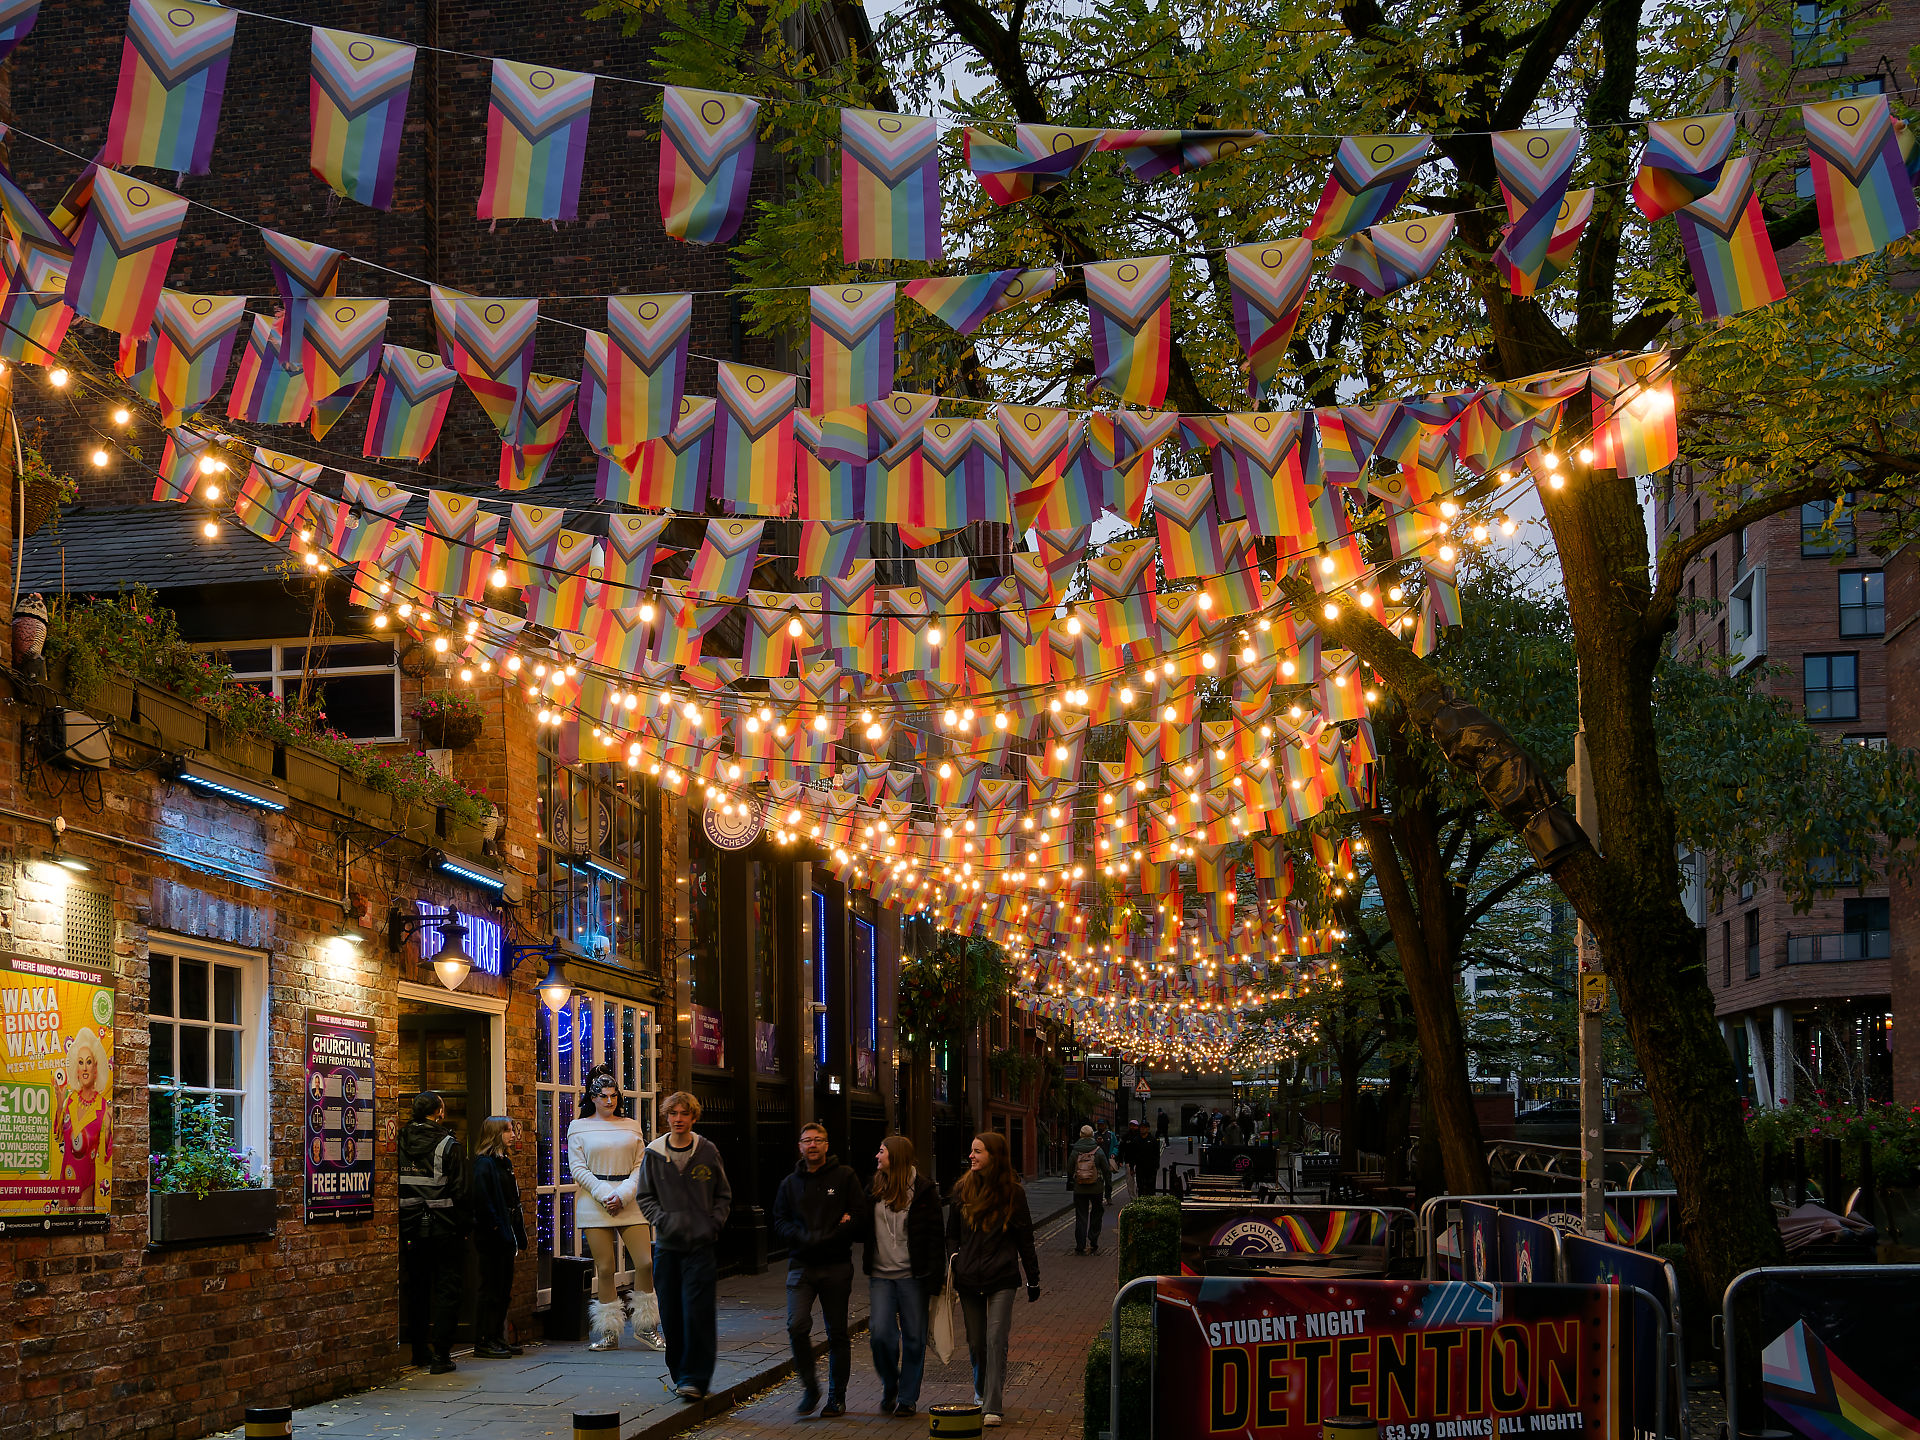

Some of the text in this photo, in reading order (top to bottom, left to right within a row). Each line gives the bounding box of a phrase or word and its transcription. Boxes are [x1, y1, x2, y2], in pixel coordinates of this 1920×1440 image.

[708, 824, 758, 847] MANCHESTER
[457, 911, 501, 976] HURCH
[11, 959, 102, 983] WHERE MUSIC COMES TO LIFE
[2, 986, 59, 1014] WAKA
[5, 1012, 60, 1033] BINGO
[6, 1030, 62, 1058] WAKA
[313, 1036, 371, 1058] CHURCH LIVE
[6, 1061, 36, 1074] MISTY
[312, 1054, 328, 1064] EVERY
[328, 1055, 347, 1066] FRIDAY
[346, 1057, 360, 1068] FROM
[0, 1085, 49, 1115] £100
[0, 1114, 49, 1126] AR TAB FOR A
[0, 1123, 49, 1134] ULL HOUSE WIN
[14, 1133, 20, 1141] A
[21, 1133, 49, 1142] CHANCE
[22, 1143, 49, 1152] BIGGER
[0, 1186, 22, 1195] EVERY
[24, 1186, 60, 1195] THURSDAY
[67, 1186, 80, 1194] 7PM
[311, 1172, 371, 1193] FREE ENTRY
[1548, 1215, 1583, 1232] CHUR
[1241, 1224, 1284, 1251] CHURCH
[1209, 1309, 1366, 1347] STUDENT NIGHT
[1209, 1319, 1580, 1434] DETENTION
[1385, 1411, 1583, 1440] £3.99 DRINKS ALL NIGHT!
